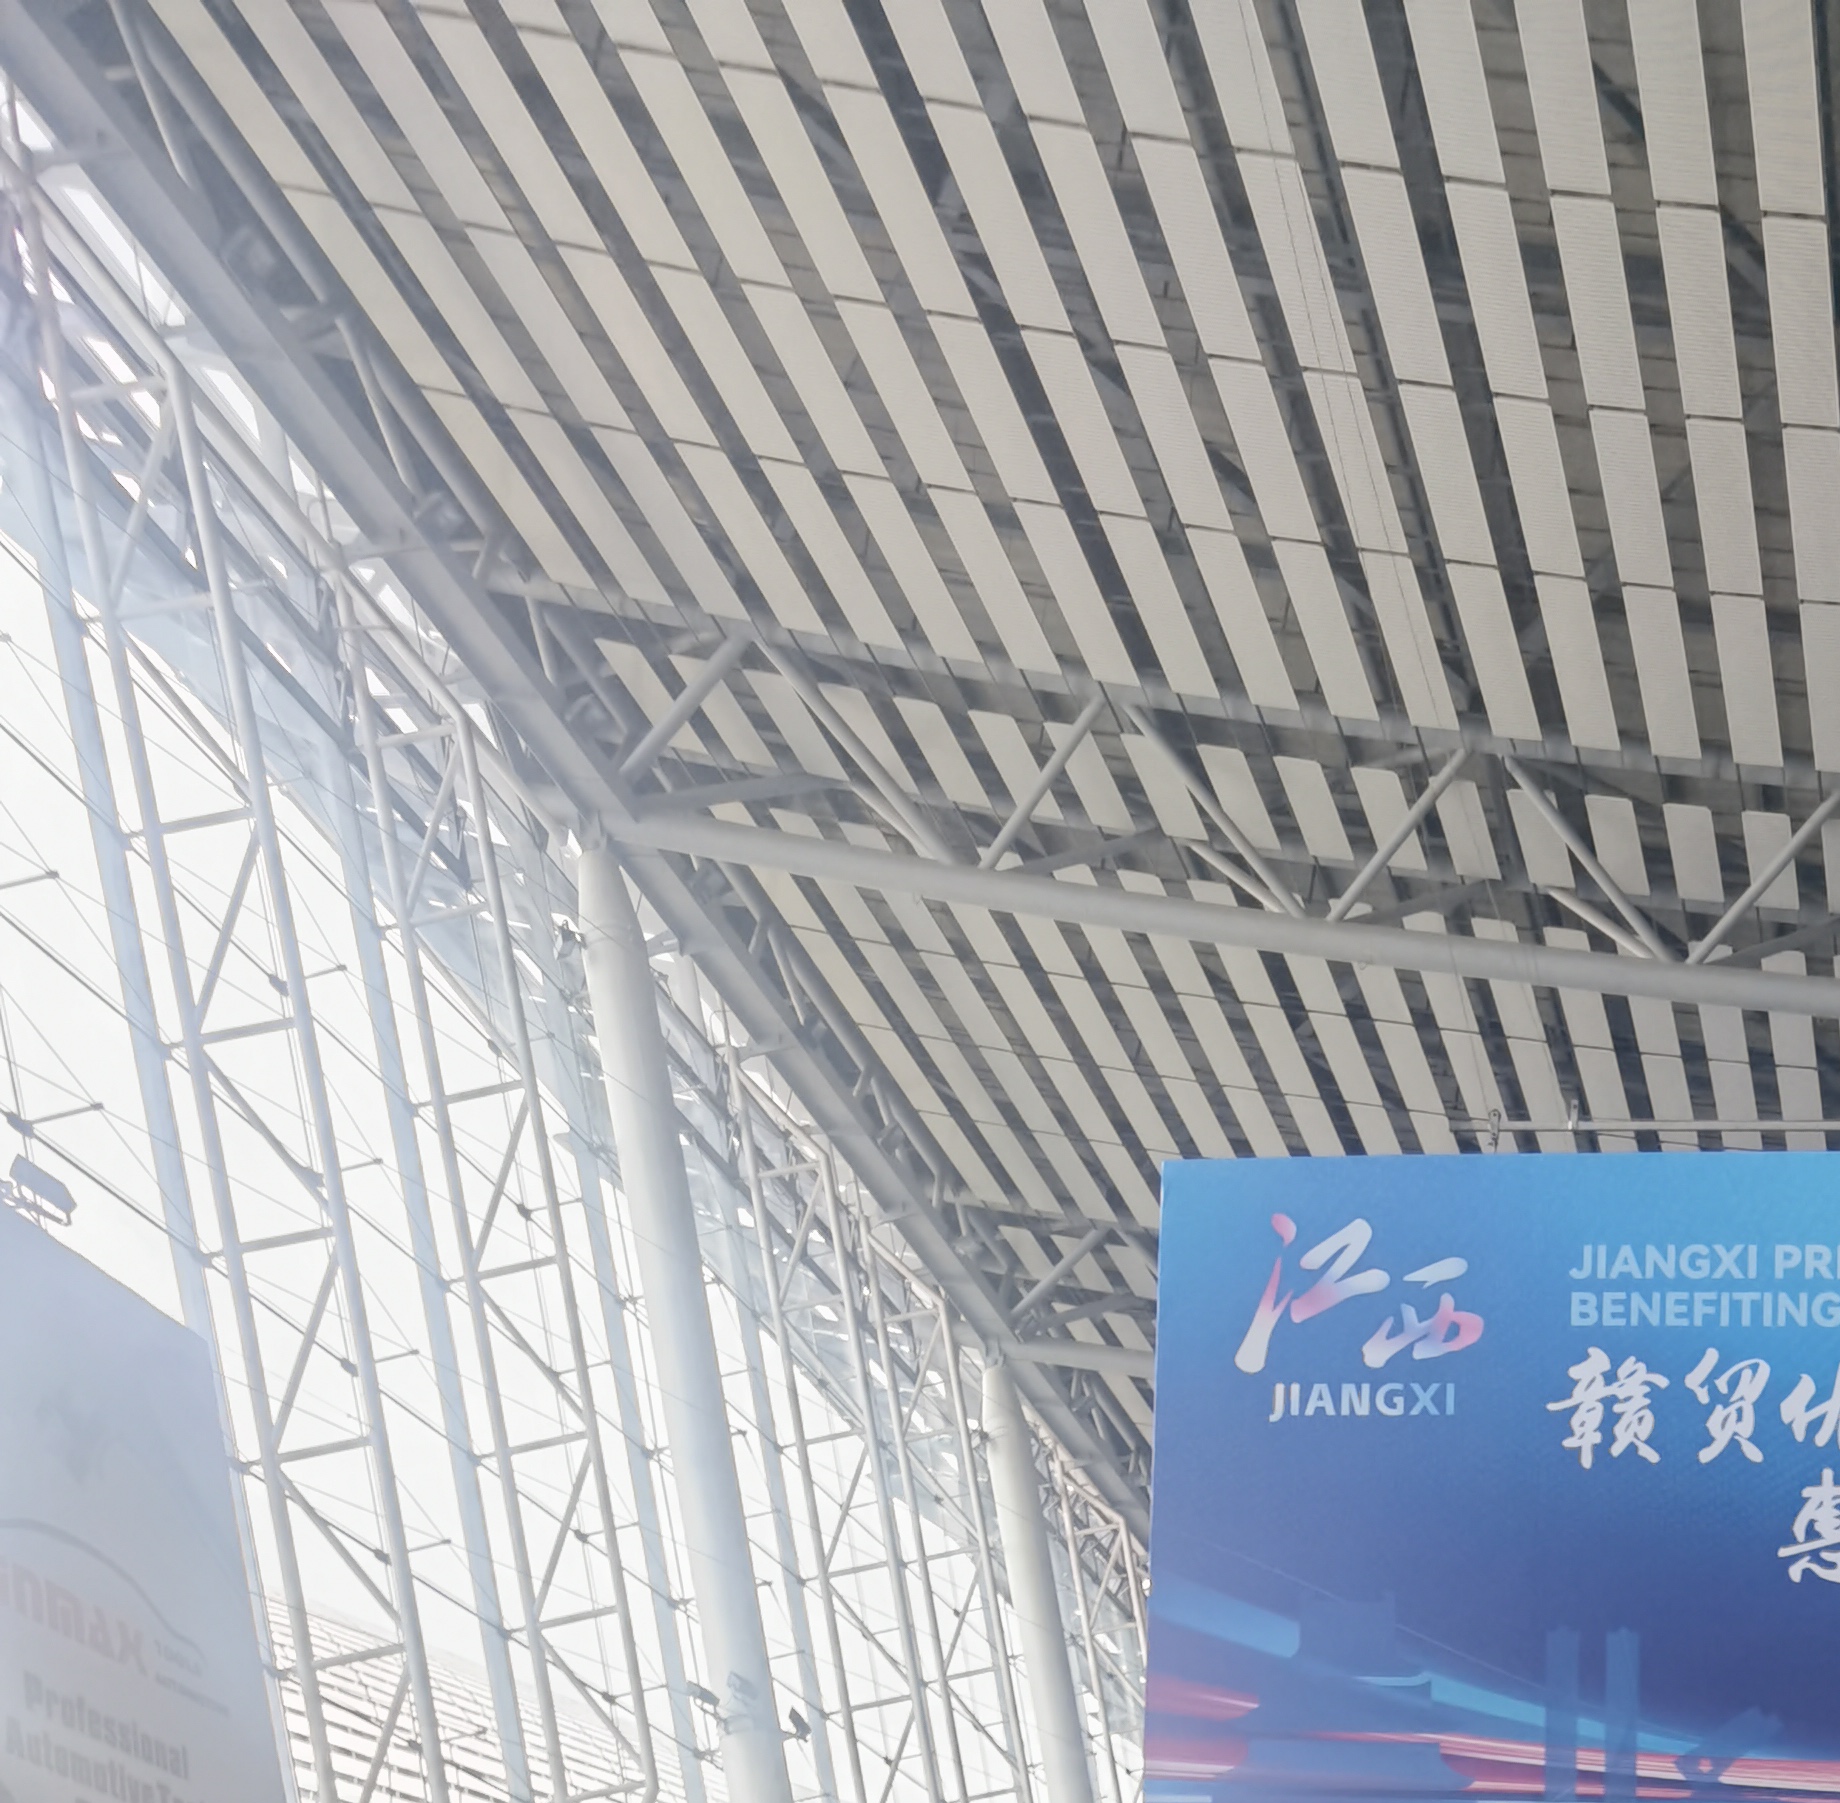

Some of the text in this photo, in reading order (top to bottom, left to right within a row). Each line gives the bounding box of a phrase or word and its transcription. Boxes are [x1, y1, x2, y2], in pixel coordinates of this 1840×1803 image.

[1234, 1211, 1486, 1374] 江西
[1567, 1243, 1762, 1283] JIANGXI
[1267, 1381, 1458, 1424] JIANGXI
[23, 1671, 190, 1781] Professional
